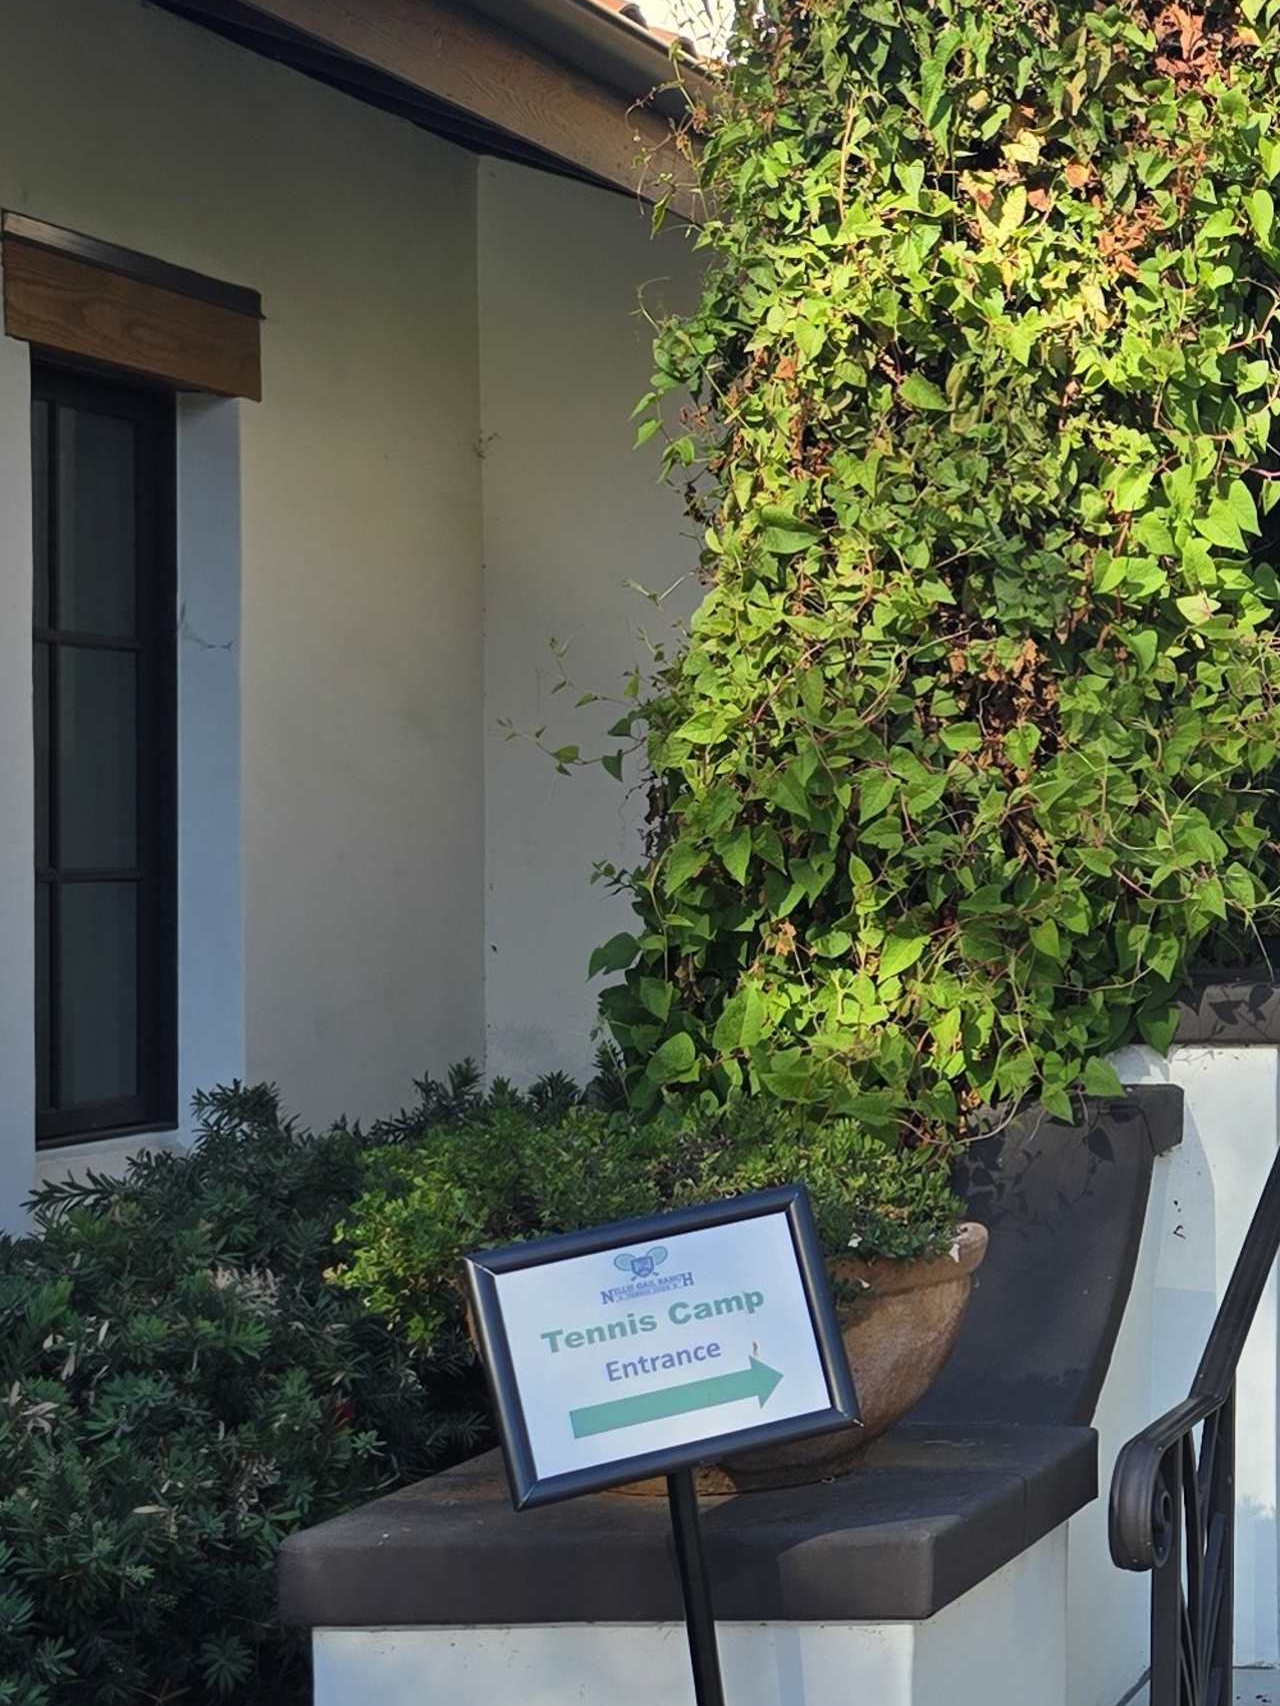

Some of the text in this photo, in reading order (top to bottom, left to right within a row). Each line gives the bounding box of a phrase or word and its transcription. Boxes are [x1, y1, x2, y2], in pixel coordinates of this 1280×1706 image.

[540, 1312, 658, 1353] Tennis
[668, 1290, 765, 1326] Camp
[605, 1342, 722, 1381] Entrance
